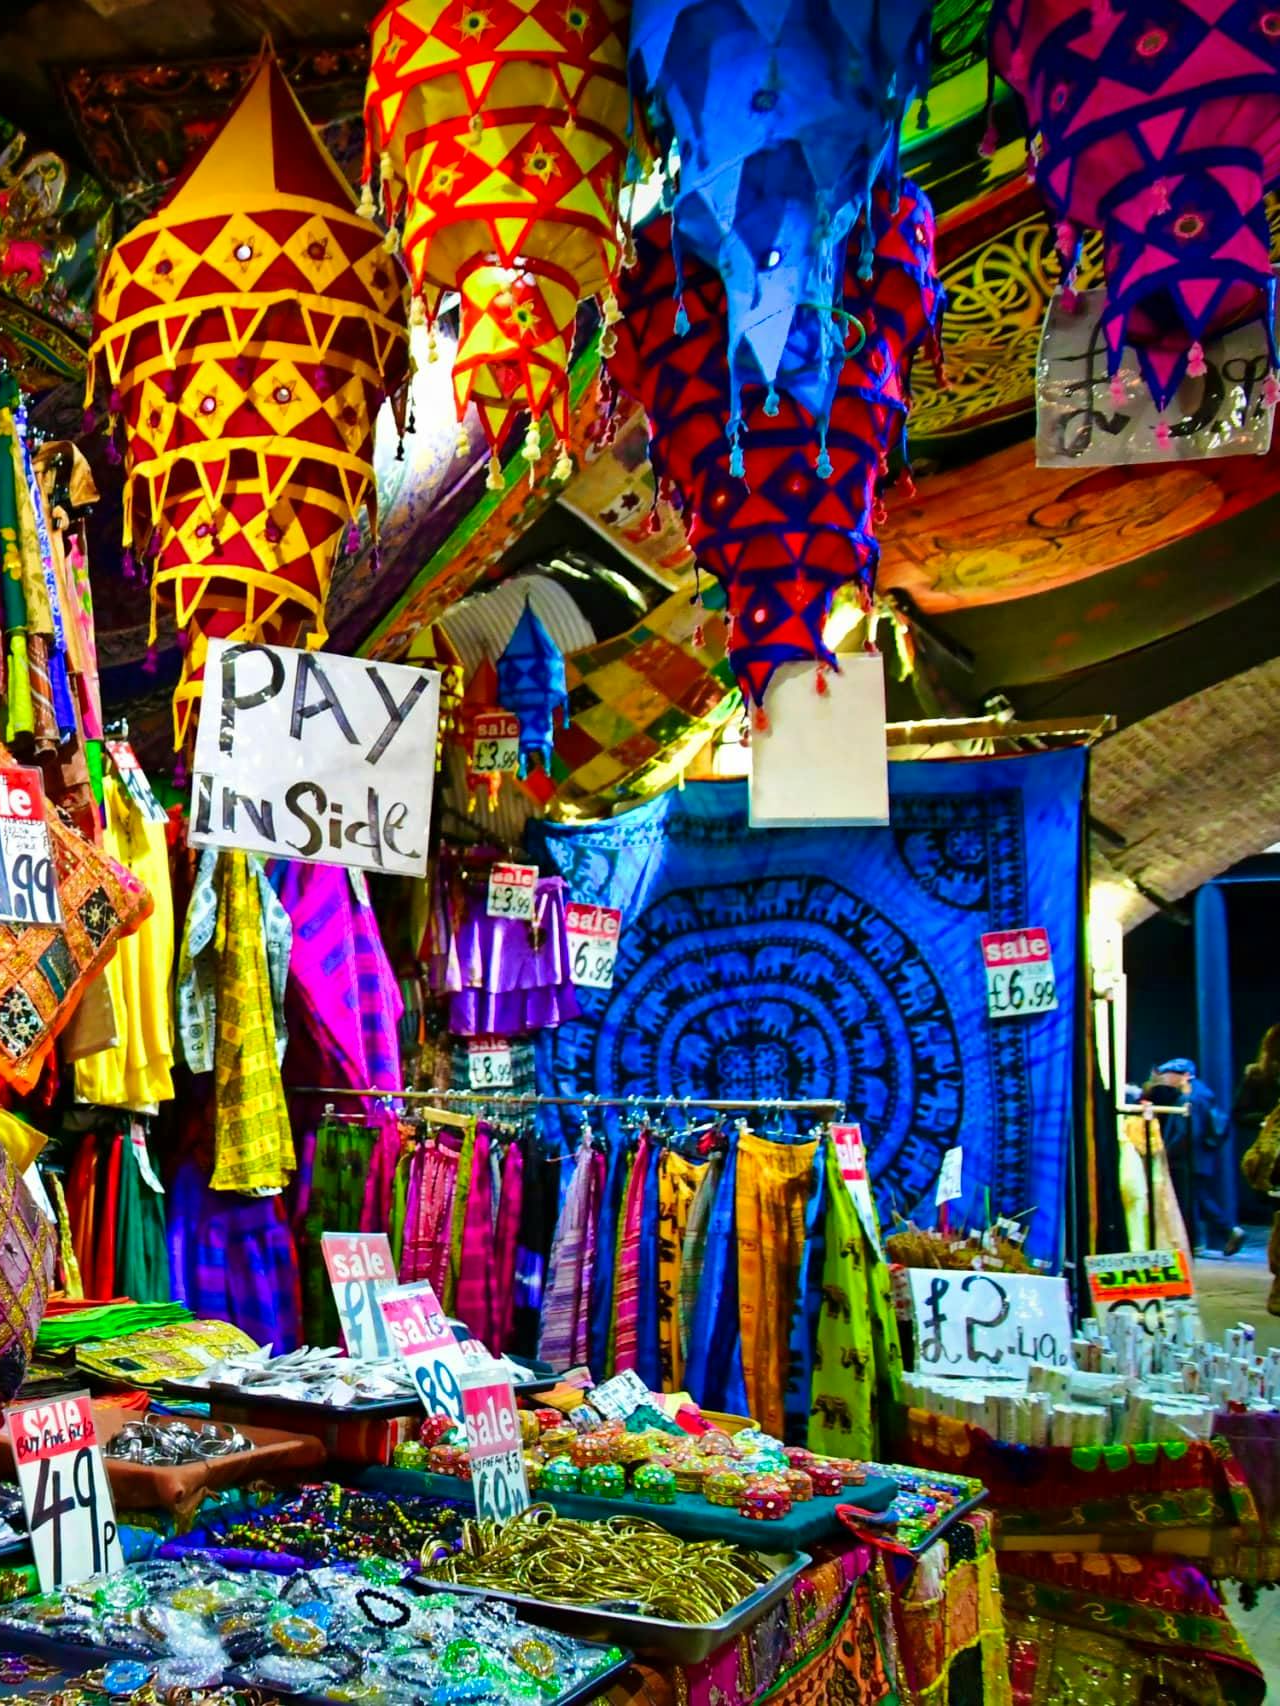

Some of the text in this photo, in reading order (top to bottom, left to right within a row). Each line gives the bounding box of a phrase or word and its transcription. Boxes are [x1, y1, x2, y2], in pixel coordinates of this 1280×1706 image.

[218, 643, 430, 766] PAY
[477, 719, 518, 737] sale
[477, 740, 517, 770] £3.99
[493, 868, 532, 884] sale
[492, 886, 530, 914] £3.99
[567, 908, 618, 933] sale
[985, 934, 1047, 961] sale
[988, 969, 1056, 1011] £6.99
[468, 1036, 509, 1050] sale
[333, 1241, 386, 1278] sale
[23, 1401, 81, 1448] sale
[466, 1396, 514, 1447] sale
[16, 1435, 40, 1459] BUY
[31, 1447, 116, 1592] 49p
